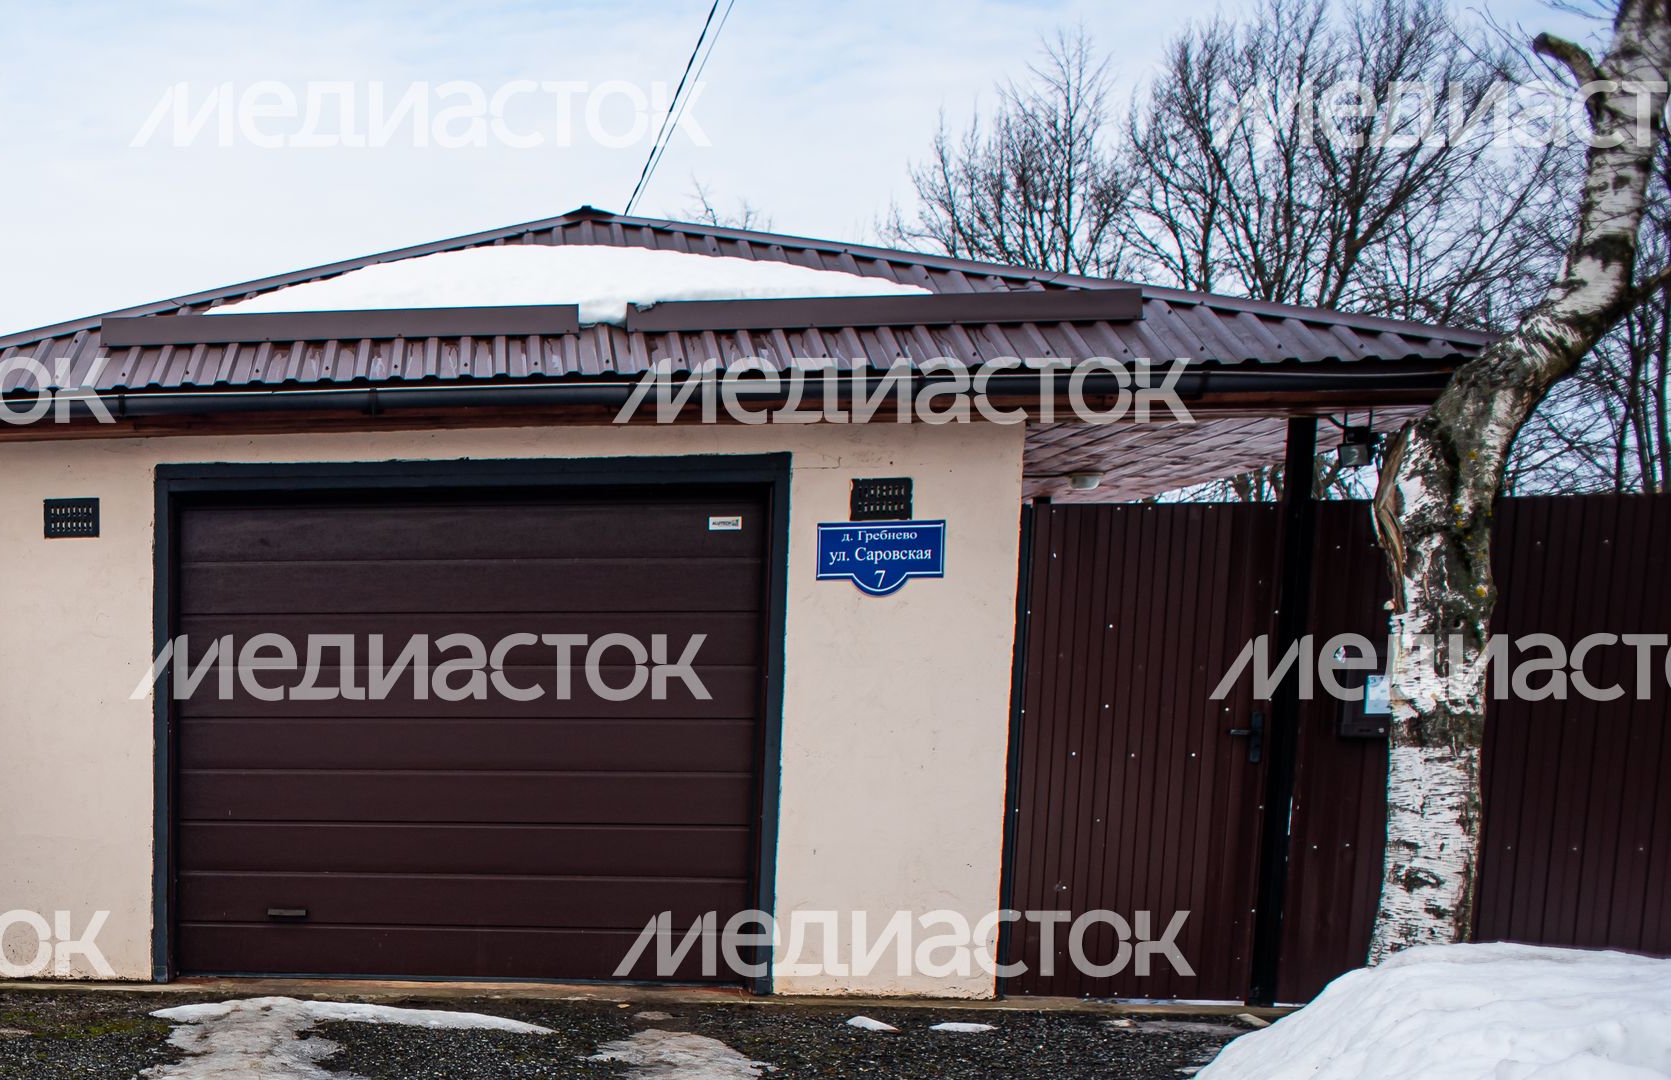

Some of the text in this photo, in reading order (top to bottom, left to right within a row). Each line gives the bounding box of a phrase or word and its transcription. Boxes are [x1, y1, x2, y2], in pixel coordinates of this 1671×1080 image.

[841, 529, 918, 543] д. Гребнево
[829, 546, 932, 565] ул. Саровская
[873, 569, 886, 588] 7
